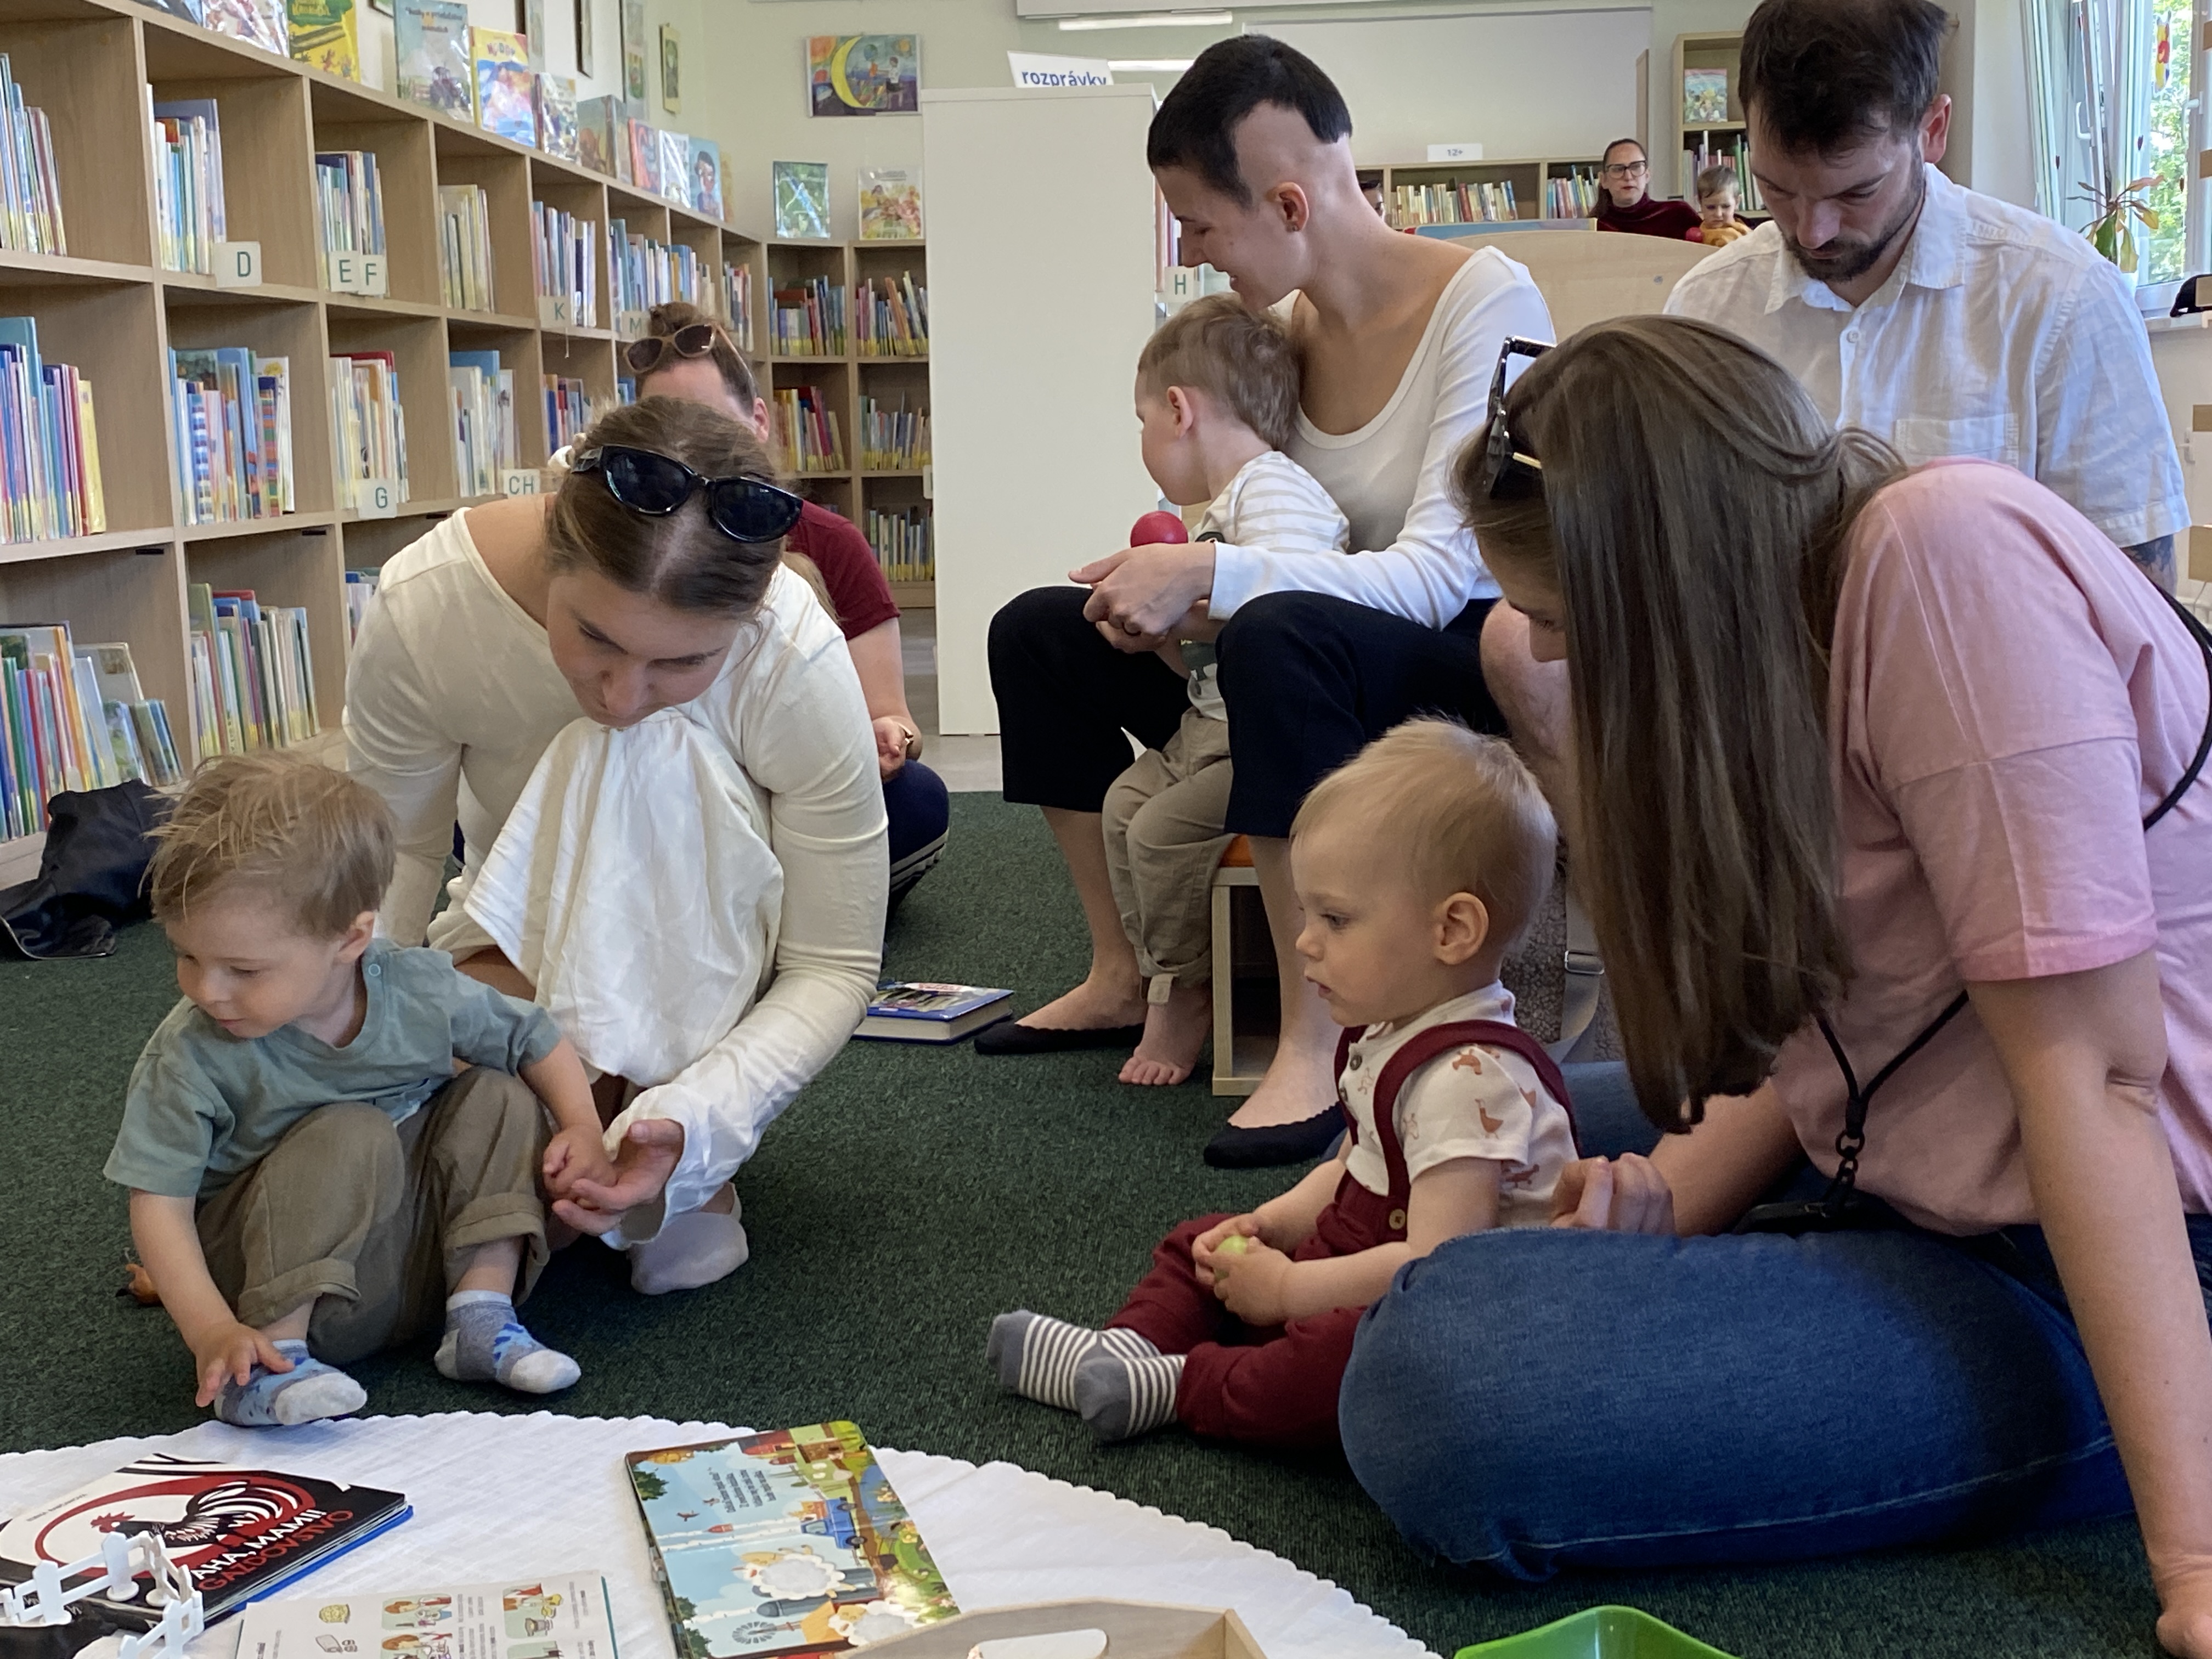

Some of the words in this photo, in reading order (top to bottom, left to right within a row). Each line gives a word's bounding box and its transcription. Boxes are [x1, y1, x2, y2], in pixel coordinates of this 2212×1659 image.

[236, 251, 251, 277] D
[338, 259, 352, 283] E
[365, 263, 377, 286] F
[1175, 273, 1186, 295] H
[554, 302, 565, 320] K
[629, 317, 642, 334] M
[509, 475, 534, 494] CH
[375, 487, 388, 509] G
[190, 1551, 257, 1580] AHA,
[244, 1509, 327, 1549] MAMI!
[198, 1510, 353, 1590] GAZDOVSTVO
